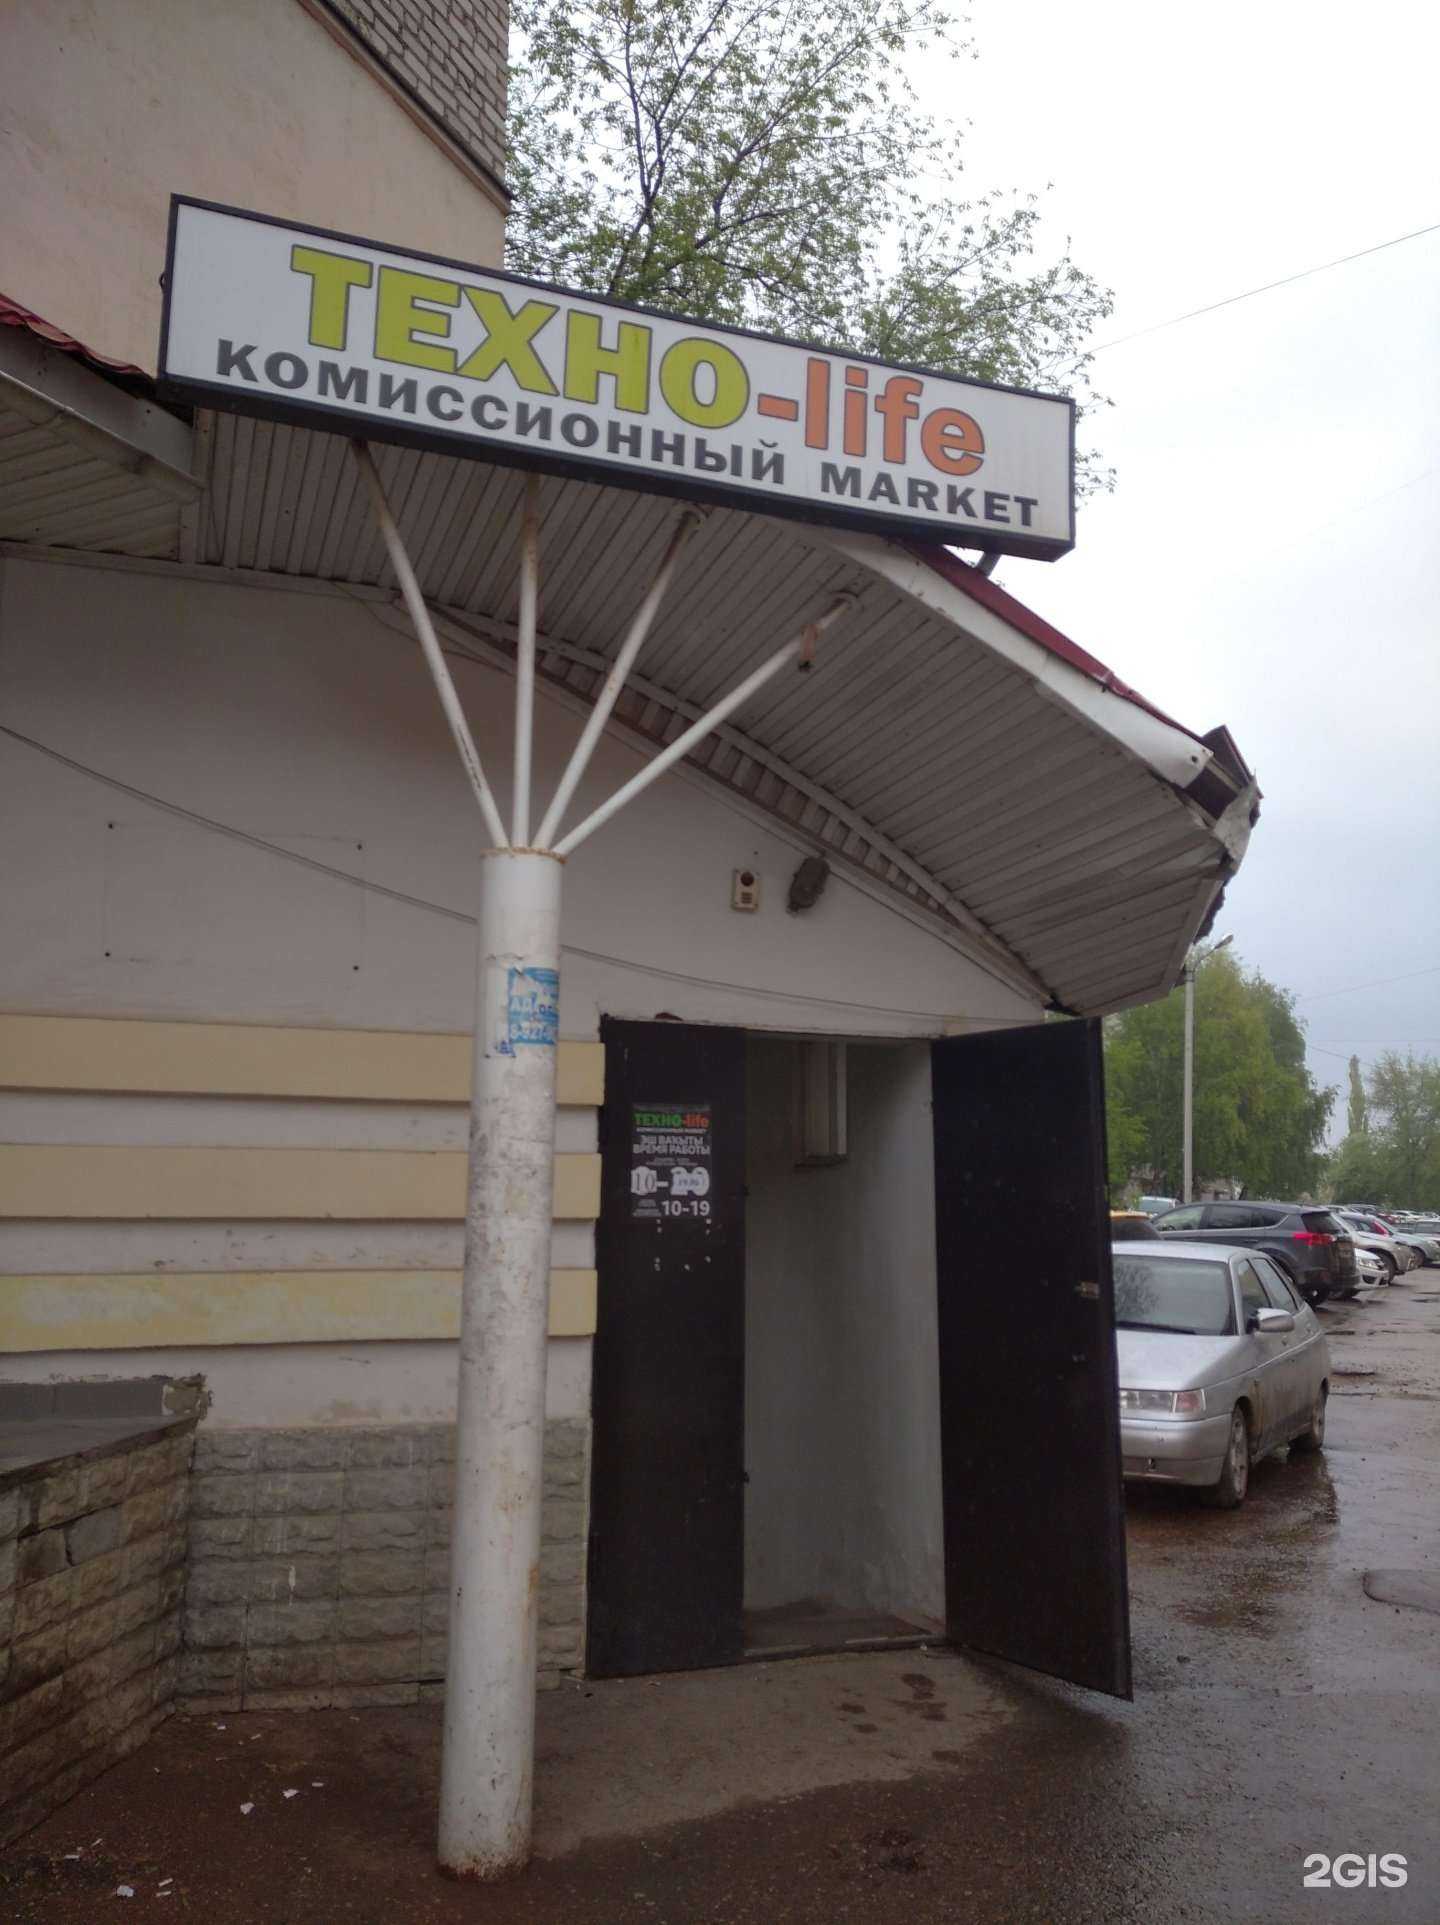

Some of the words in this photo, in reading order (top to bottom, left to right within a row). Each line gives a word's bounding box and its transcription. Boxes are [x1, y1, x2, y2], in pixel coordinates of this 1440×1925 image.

[290, 243, 986, 477] ТЕХНО-life
[216, 338, 785, 485] КОМИССИОННЫЙ
[820, 461, 1039, 527] MARKET
[634, 1112, 710, 1128] ТЕХНО-life
[632, 1144, 668, 1155] ВРЕМЯ
[669, 1144, 711, 1155] РАБОТЫ
[661, 1200, 711, 1217] 10-19
